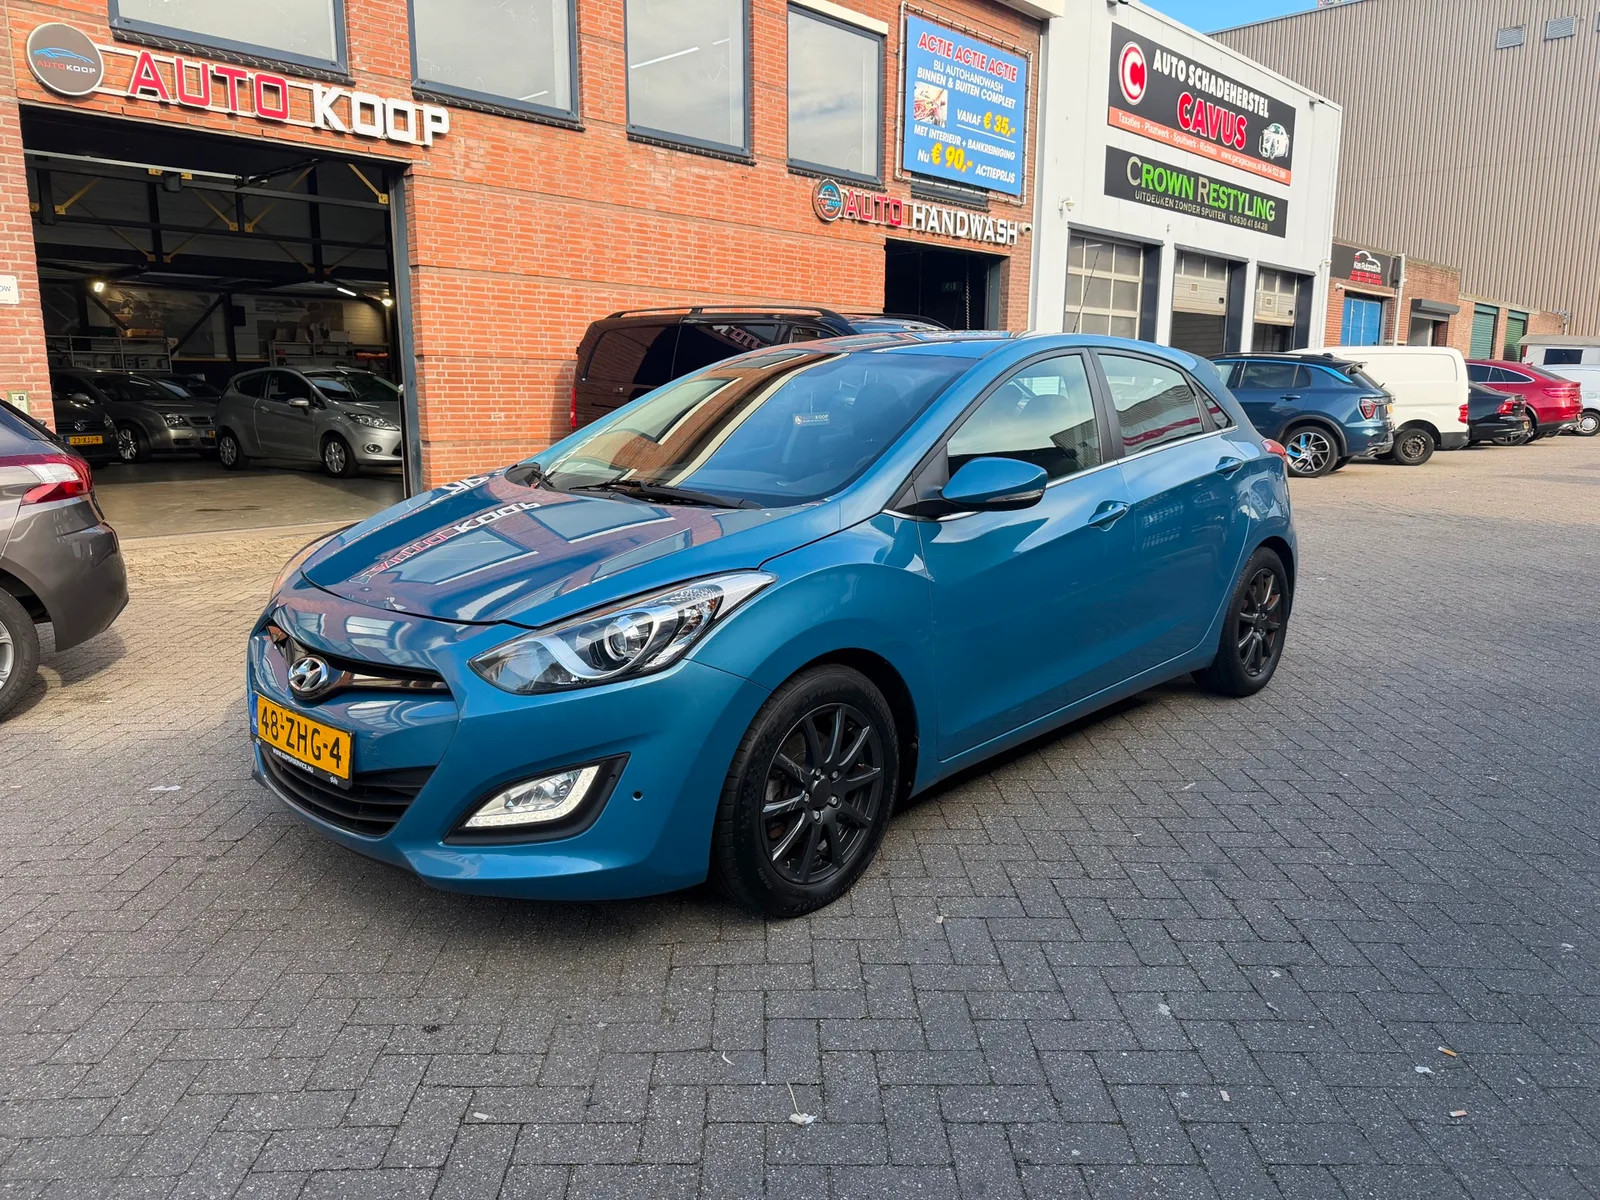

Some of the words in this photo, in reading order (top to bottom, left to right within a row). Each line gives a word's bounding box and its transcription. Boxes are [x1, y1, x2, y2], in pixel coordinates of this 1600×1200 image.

[37, 60, 96, 73] AUTOKOOP
[917, 32, 954, 59] ACTIE
[954, 45, 987, 71] ACTIE
[987, 58, 1018, 83] ACTIE
[934, 60, 944, 72] BIJ
[945, 63, 1004, 93] AUTOHANDWASH
[128, 50, 290, 121] AUTO
[313, 82, 450, 147] KOOP
[917, 67, 946, 86] BINNEN
[947, 78, 953, 88] &
[955, 80, 980, 97] BUITEN
[981, 89, 1016, 109] COMPLEET
[1152, 49, 1186, 82] AUTO
[1188, 64, 1269, 118] SCHADEHERSTEL
[957, 108, 981, 125] VANAF
[983, 111, 992, 129] €
[1177, 91, 1248, 150] CAVUS
[914, 124, 928, 136] MET
[928, 128, 962, 146] INTERIEUR
[967, 139, 1016, 160] BANKREINIGING
[931, 142, 942, 165] €
[975, 164, 1016, 184] ACTIEPRIJS
[1126, 156, 1194, 200] CROWN
[1197, 176, 1275, 221] RESTYLING
[1135, 190, 1175, 208] UITDEUKEN
[1175, 201, 1201, 214] ZONDER
[1201, 207, 1226, 221] SPUITEN
[844, 190, 904, 226] AUTO
[912, 202, 1018, 244] HANDWASH
[261, 706, 342, 769] 48-ZHG-4
